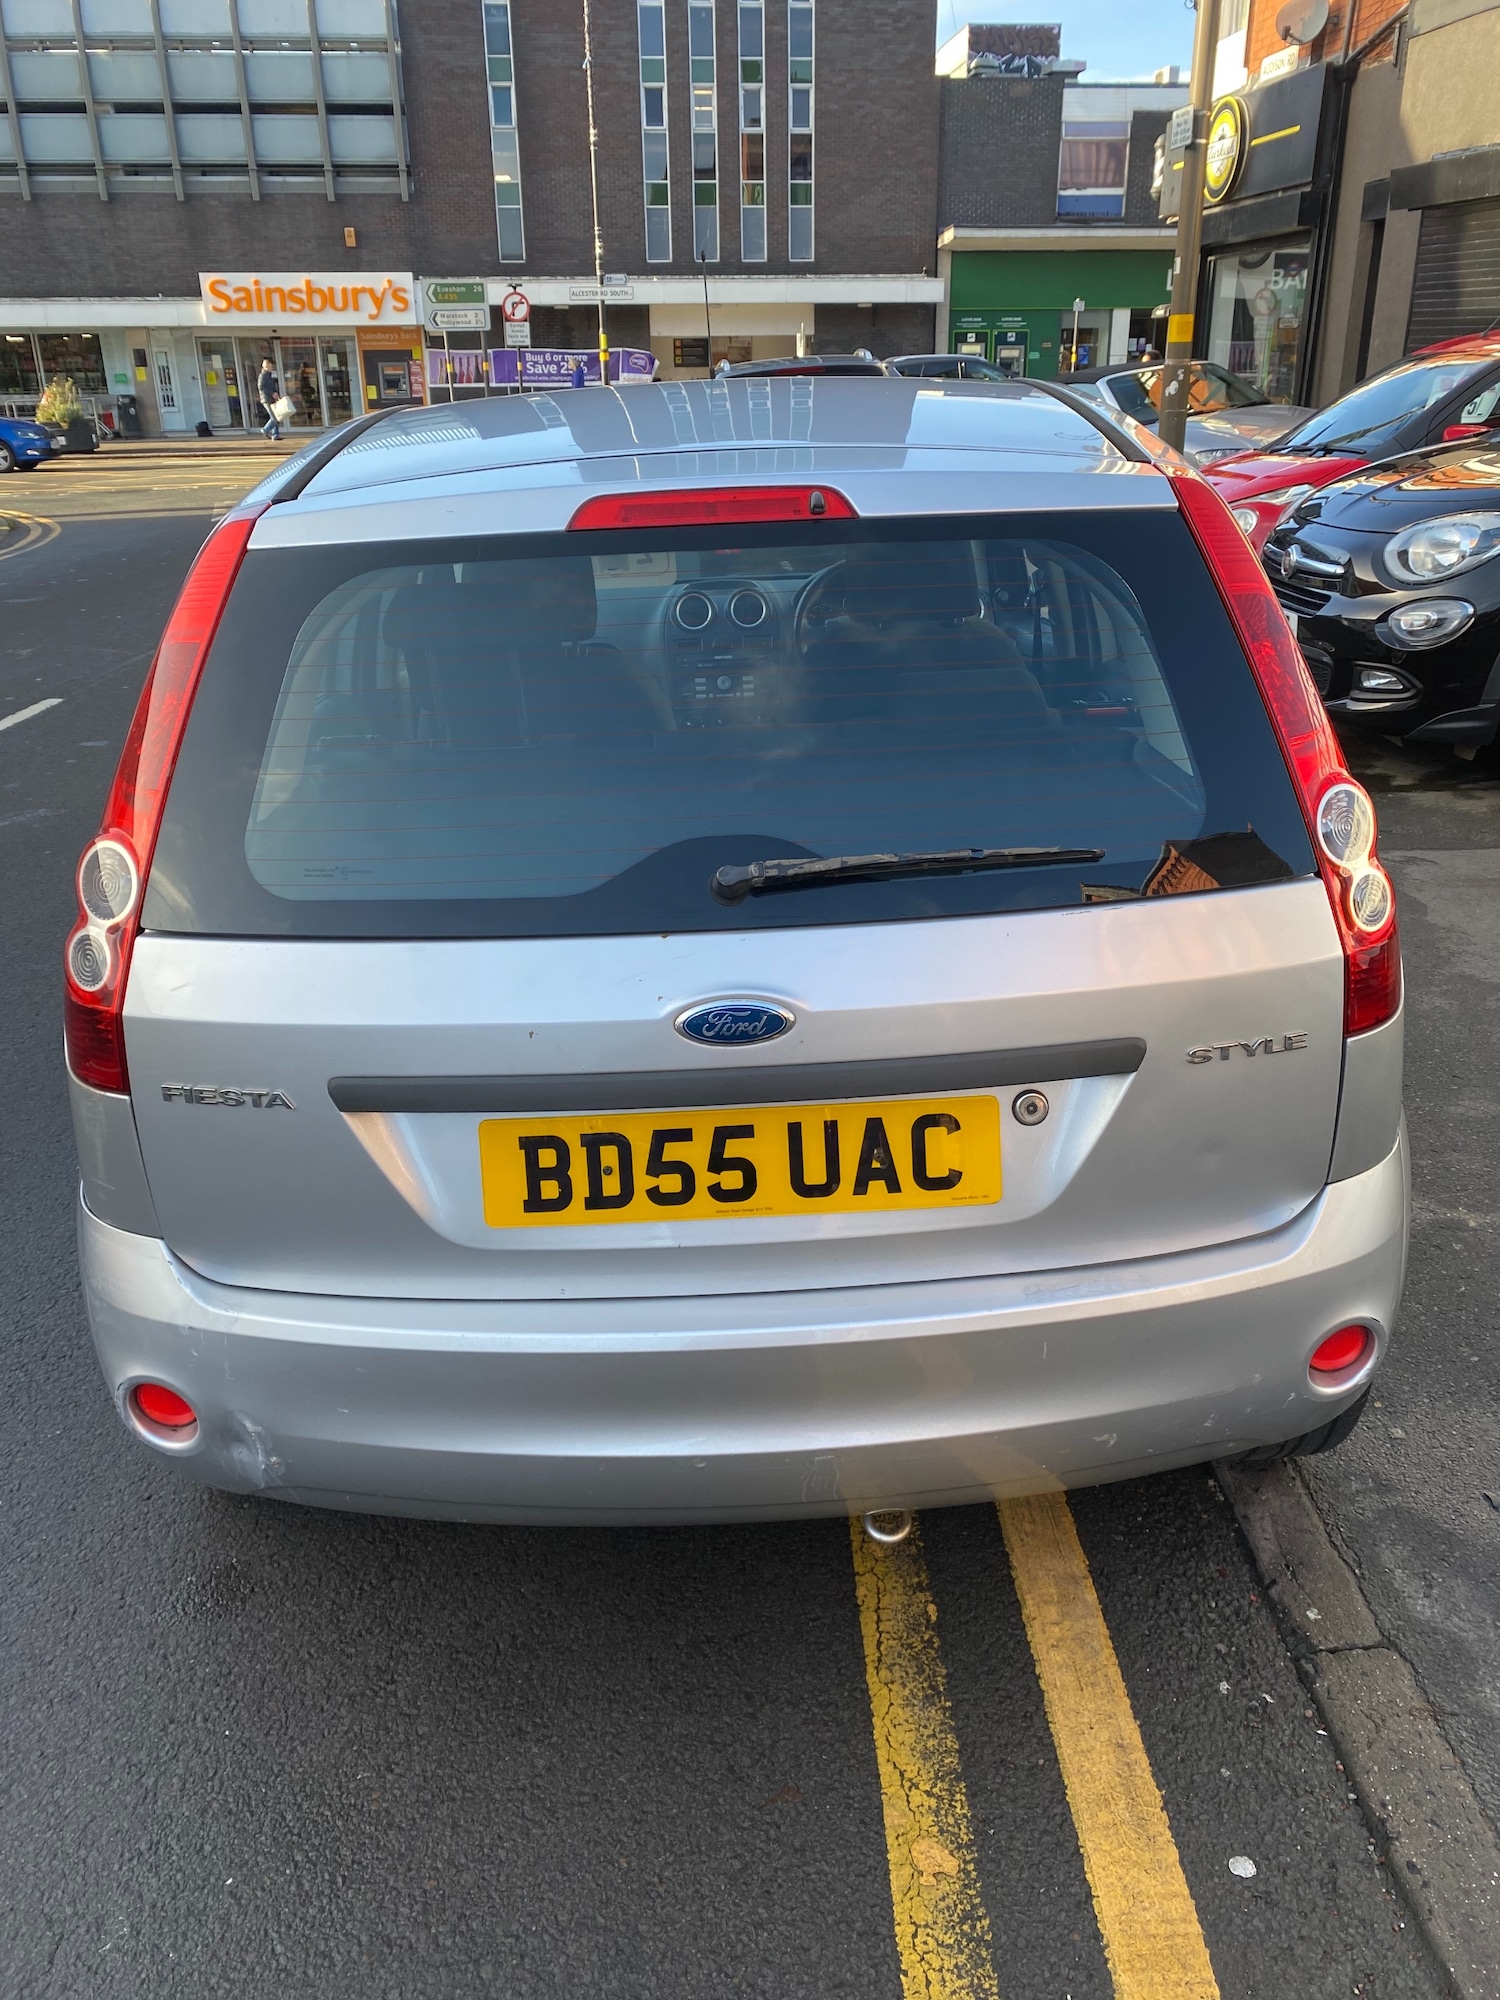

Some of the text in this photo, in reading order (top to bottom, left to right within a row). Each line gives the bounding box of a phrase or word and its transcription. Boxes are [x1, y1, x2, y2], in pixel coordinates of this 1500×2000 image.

[207, 278, 409, 320] Sainsbury's
[360, 331, 399, 341] Sainsbury's
[525, 352, 544, 363] Buy
[545, 353, 552, 361] 6
[526, 362, 557, 374] Save
[702, 1010, 768, 1037] Ford
[1186, 1031, 1309, 1064] STYLE
[160, 1084, 296, 1110] FIESTA
[518, 1113, 964, 1213] BD55 UAC
